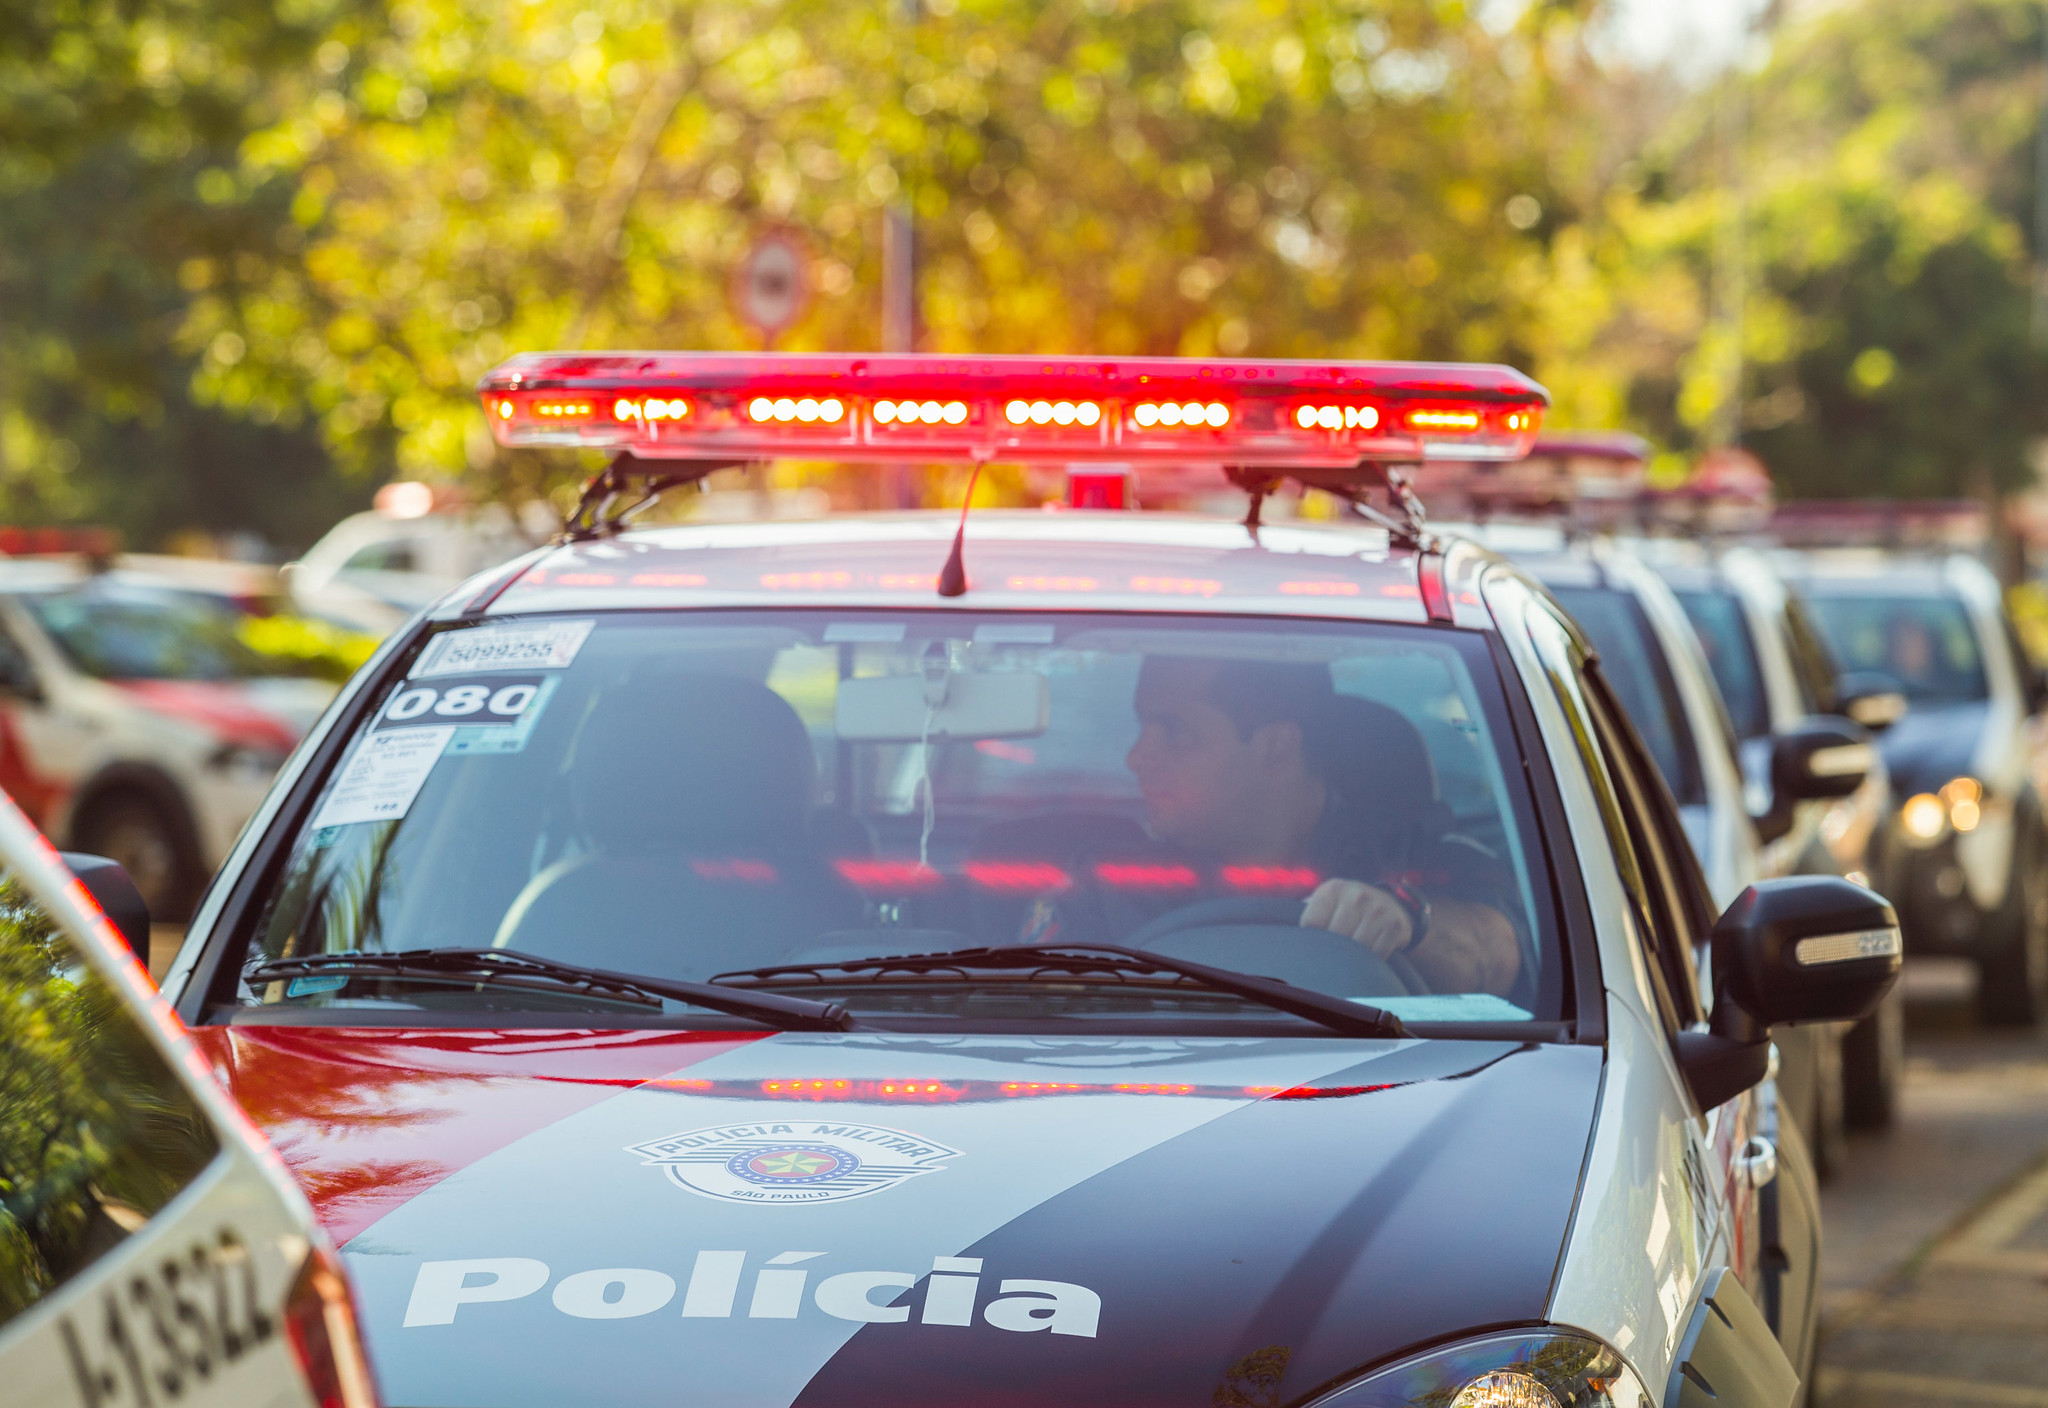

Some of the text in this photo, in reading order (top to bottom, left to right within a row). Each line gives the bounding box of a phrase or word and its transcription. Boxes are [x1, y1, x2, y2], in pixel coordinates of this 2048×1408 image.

[385, 685, 538, 720] 080
[814, 1124, 935, 1158] MILITAR
[771, 1191, 830, 1200] PAULO
[403, 1250, 1102, 1339] Polícia
